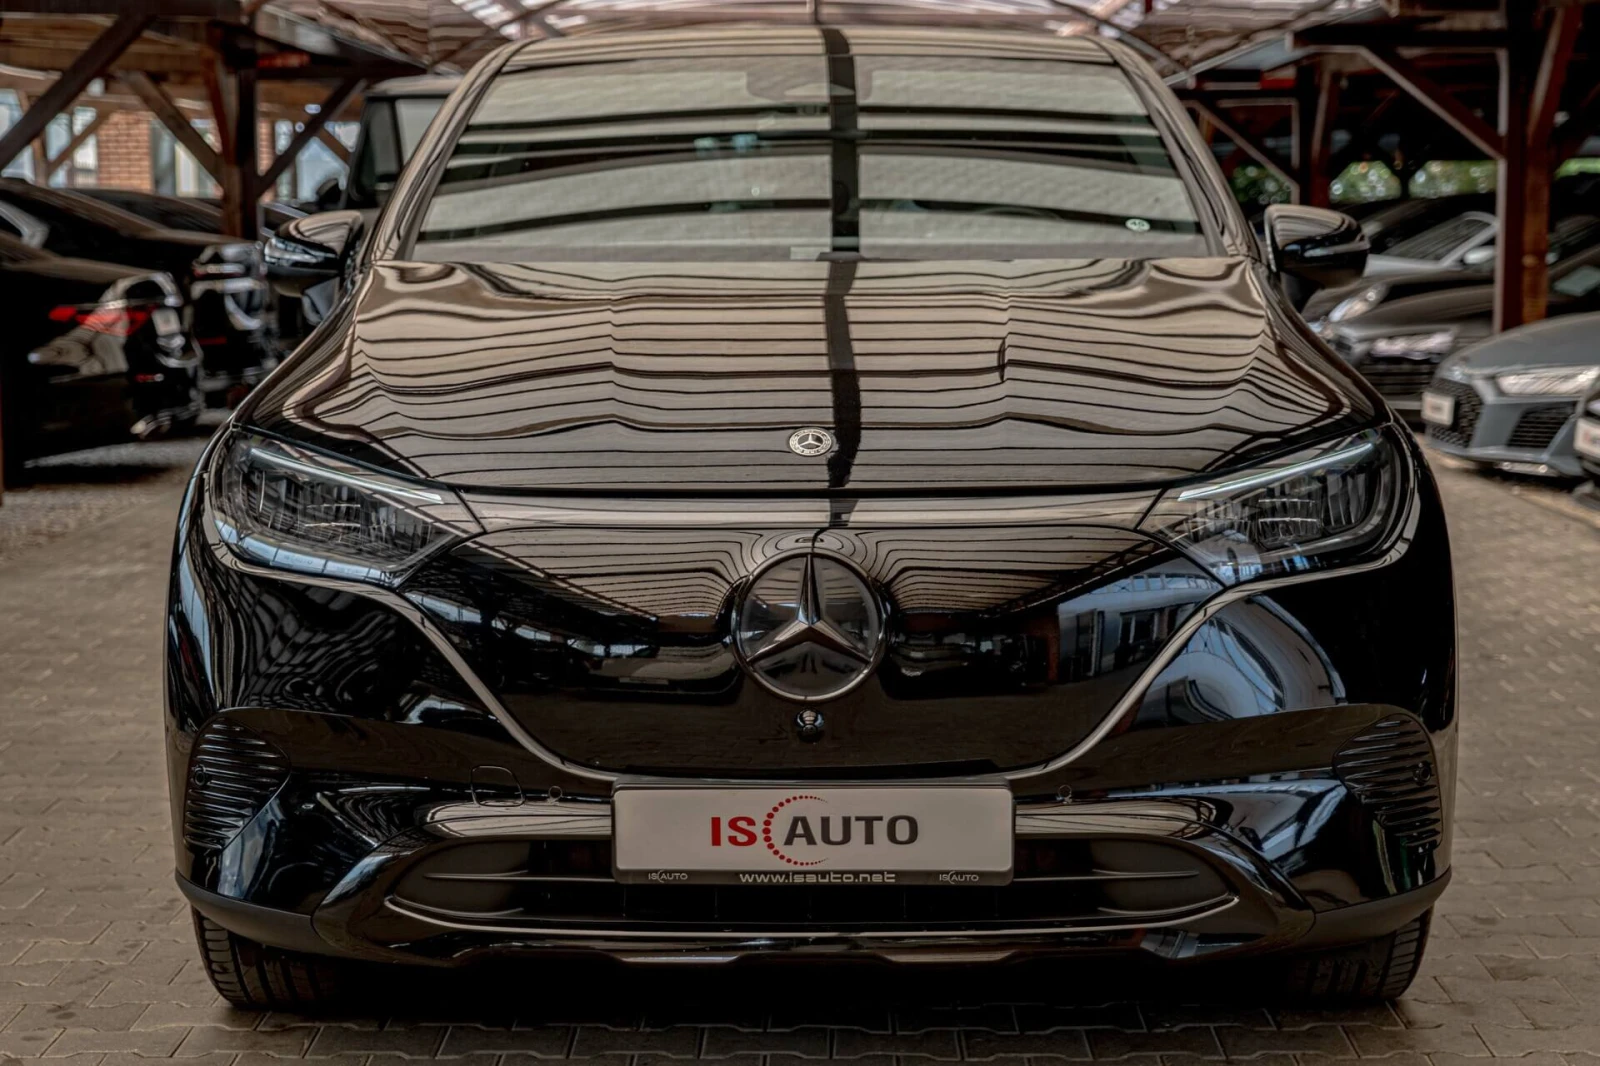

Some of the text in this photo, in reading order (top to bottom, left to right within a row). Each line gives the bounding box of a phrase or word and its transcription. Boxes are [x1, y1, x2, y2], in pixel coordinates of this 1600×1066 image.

[711, 815, 919, 847] IS AUTO
[739, 871, 896, 883] www.isauto.net
